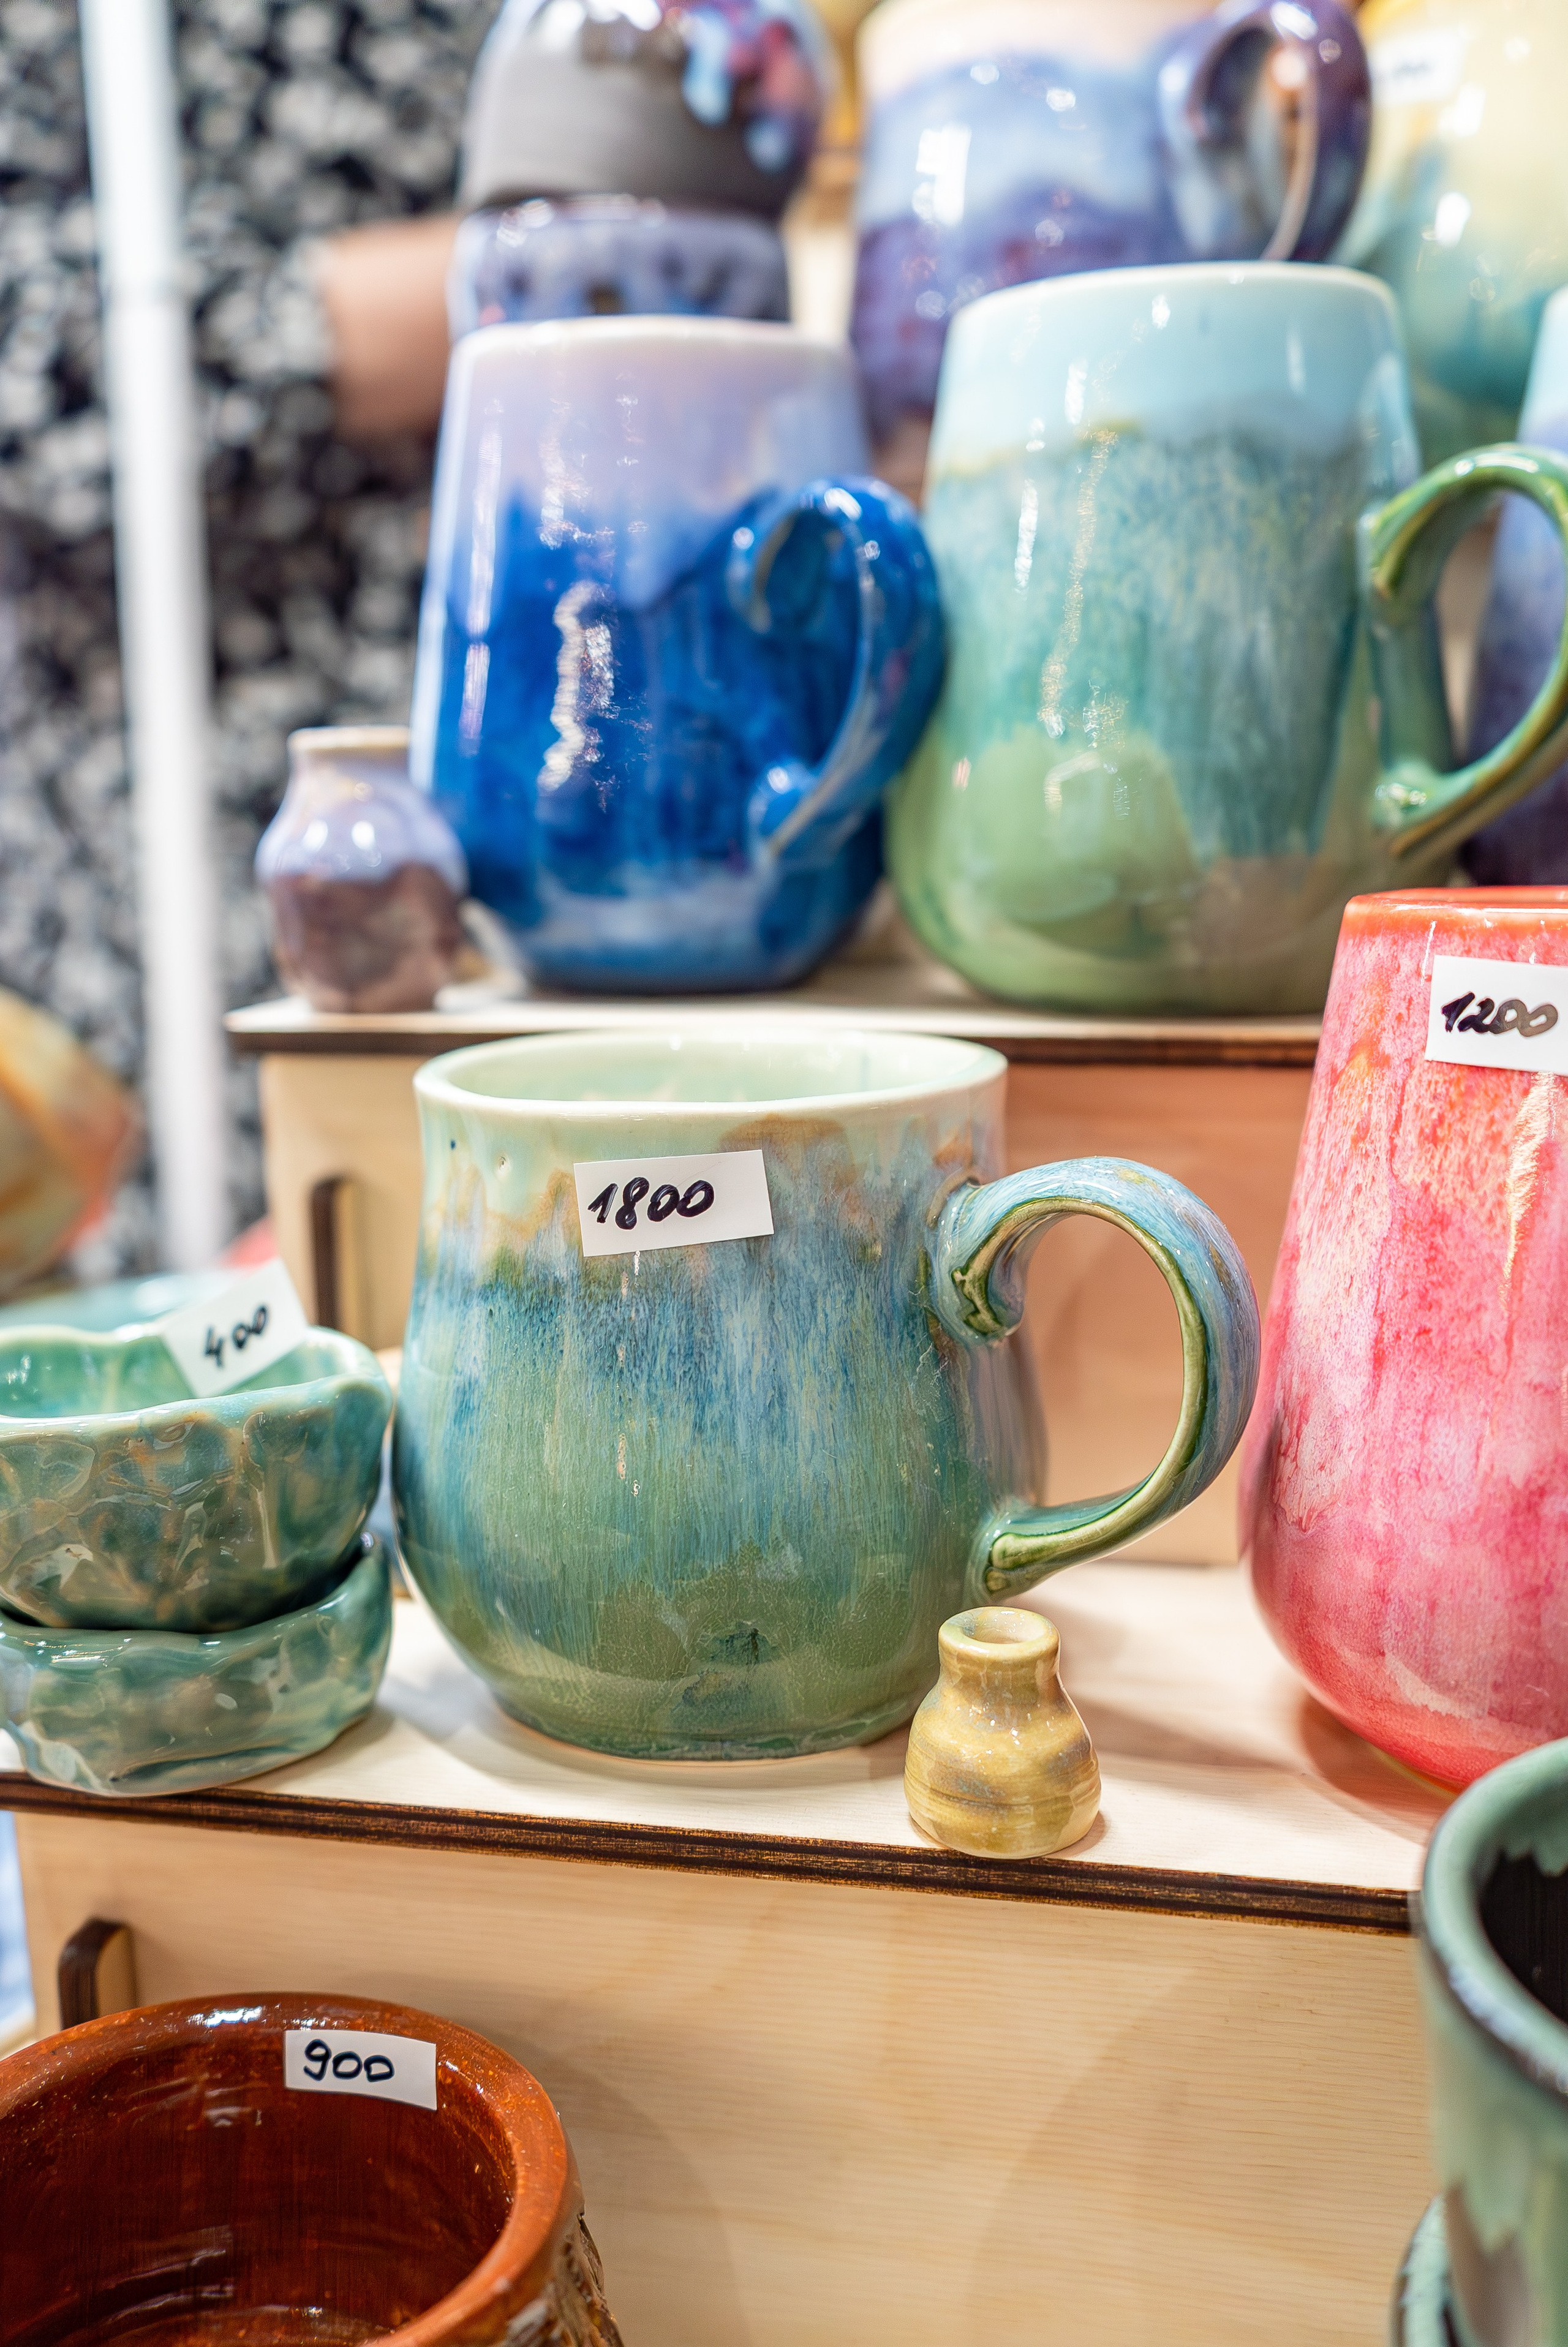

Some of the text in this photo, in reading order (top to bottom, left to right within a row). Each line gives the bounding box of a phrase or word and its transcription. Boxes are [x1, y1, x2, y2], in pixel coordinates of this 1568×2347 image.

[1441, 992, 1559, 1037] 1200
[587, 1177, 715, 1230] 1800
[203, 1303, 268, 1368] 400
[303, 2039, 395, 2082] 900
